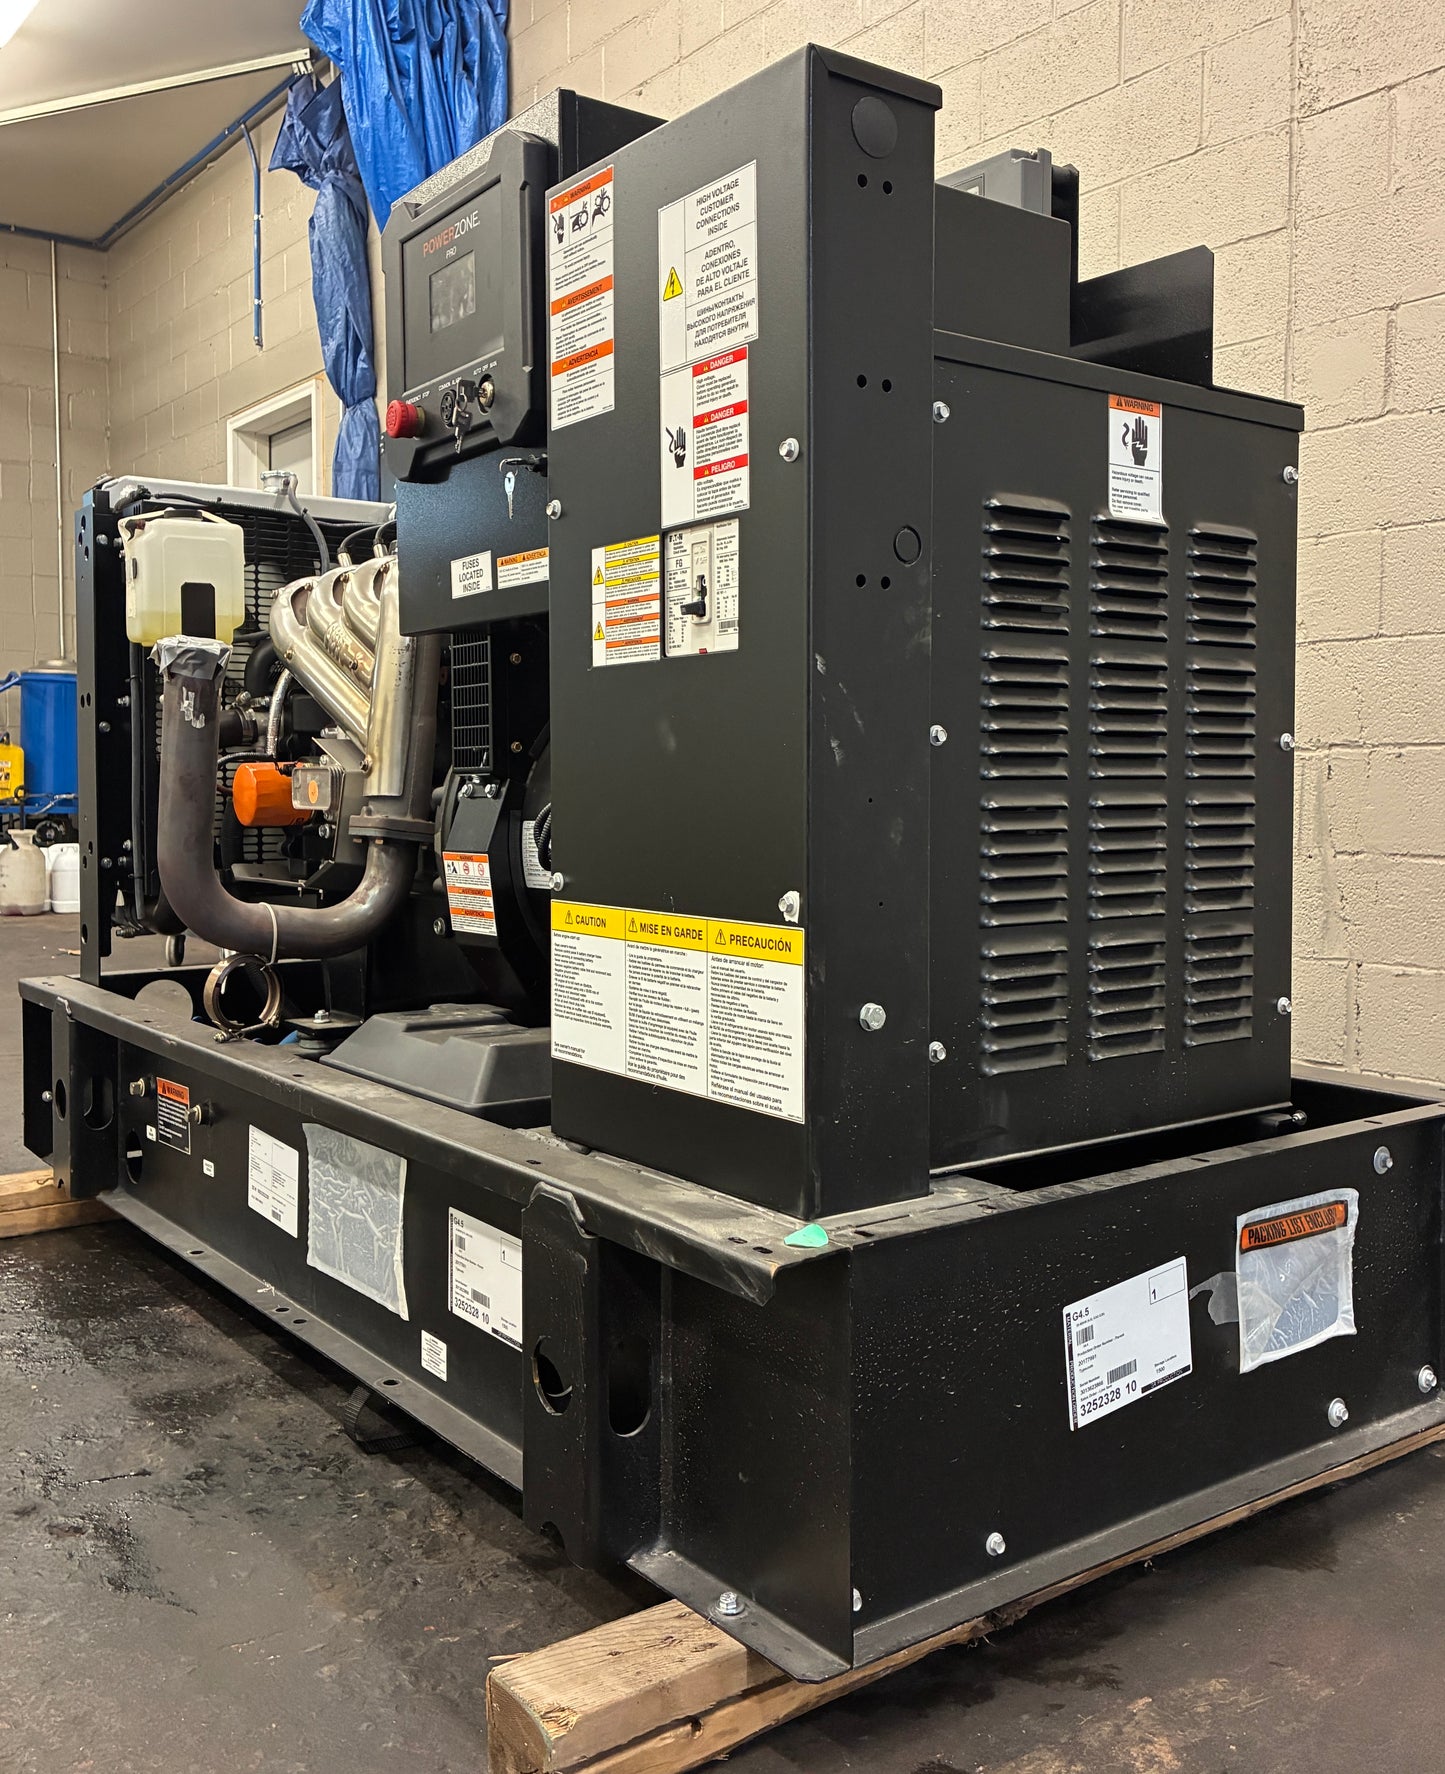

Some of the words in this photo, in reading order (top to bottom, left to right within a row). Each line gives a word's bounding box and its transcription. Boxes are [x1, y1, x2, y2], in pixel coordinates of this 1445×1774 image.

[570, 183, 590, 198] WARNING
[696, 191, 710, 206] HIGH
[711, 177, 739, 199] VOLTAGE
[700, 192, 733, 216] CUSTOMER
[696, 201, 739, 230] CONNECTIONS
[707, 219, 727, 236] INSIDE
[446, 246, 456, 259] PRO
[704, 238, 735, 260] ADENTRO,
[701, 247, 740, 273] CONEXIONES
[696, 275, 704, 287] DE
[705, 268, 720, 283] ALTO
[721, 256, 747, 276] VOLTAJE
[697, 284, 712, 298] PARA
[714, 280, 721, 290] EL
[723, 268, 749, 287] CLIENTE
[568, 285, 602, 304] AVERTISSEMENT
[687, 312, 715, 331] ВЫСОКОГО
[716, 296, 755, 319] НАПРЯЖЕНИЯ
[695, 326, 706, 339] ДЛЯ
[707, 310, 746, 334] ПОТРЕБИТЕЛЯ
[694, 328, 725, 349] НАХОДЯТСЯ
[727, 320, 748, 336] ВНУТРИ
[568, 349, 598, 366] ADVERTENCIA
[710, 353, 733, 369] DANGER
[710, 406, 733, 422] DANGER
[1123, 399, 1153, 412] WARNING
[711, 458, 735, 474] PELIGRO
[462, 557, 479, 570] FUSES
[676, 558, 682, 568] FG
[459, 567, 483, 582] LOCATED
[462, 580, 480, 593] INSIDE
[575, 913, 606, 928] CAUTION
[639, 921, 658, 934] MISE
[661, 924, 671, 936] EN
[674, 926, 702, 941] GARDE
[729, 931, 791, 952] PRECAUCIÓN
[453, 1215, 463, 1228] G4.5
[1248, 1222, 1286, 1244] PACKING
[1286, 1217, 1306, 1235] LIST
[502, 1248, 505, 1261] 1
[1151, 1288, 1156, 1300] 1
[454, 1296, 479, 1319] 3252328
[481, 1311, 489, 1325] 10
[1072, 1305, 1089, 1322] G4.5
[1080, 1386, 1120, 1417] 3252328
[1125, 1378, 1136, 1395] 10
